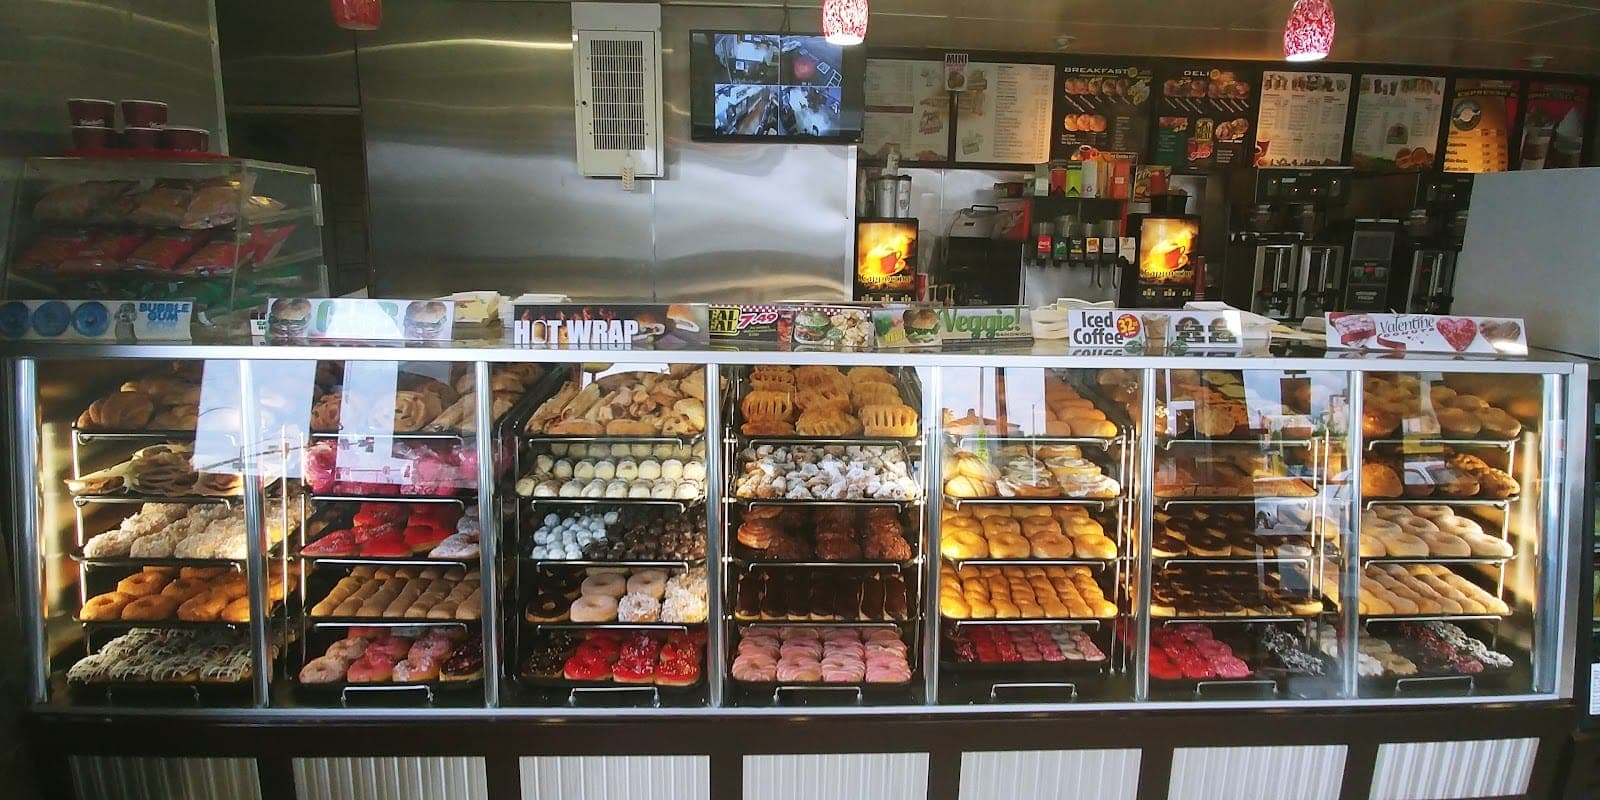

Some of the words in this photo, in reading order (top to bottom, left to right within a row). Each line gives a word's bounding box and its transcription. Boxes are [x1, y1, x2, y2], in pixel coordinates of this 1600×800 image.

[945, 54, 968, 64] MINI
[1064, 66, 1128, 75] BREAKFAST
[139, 302, 190, 313] BUBBLE
[147, 311, 178, 321] GUM
[936, 306, 1021, 339] Veggie!
[1081, 311, 1114, 328] Iced
[1380, 316, 1435, 334] Valentine
[514, 319, 562, 344] HOT
[566, 319, 638, 344] WRAP
[1073, 327, 1124, 345] Coffee
